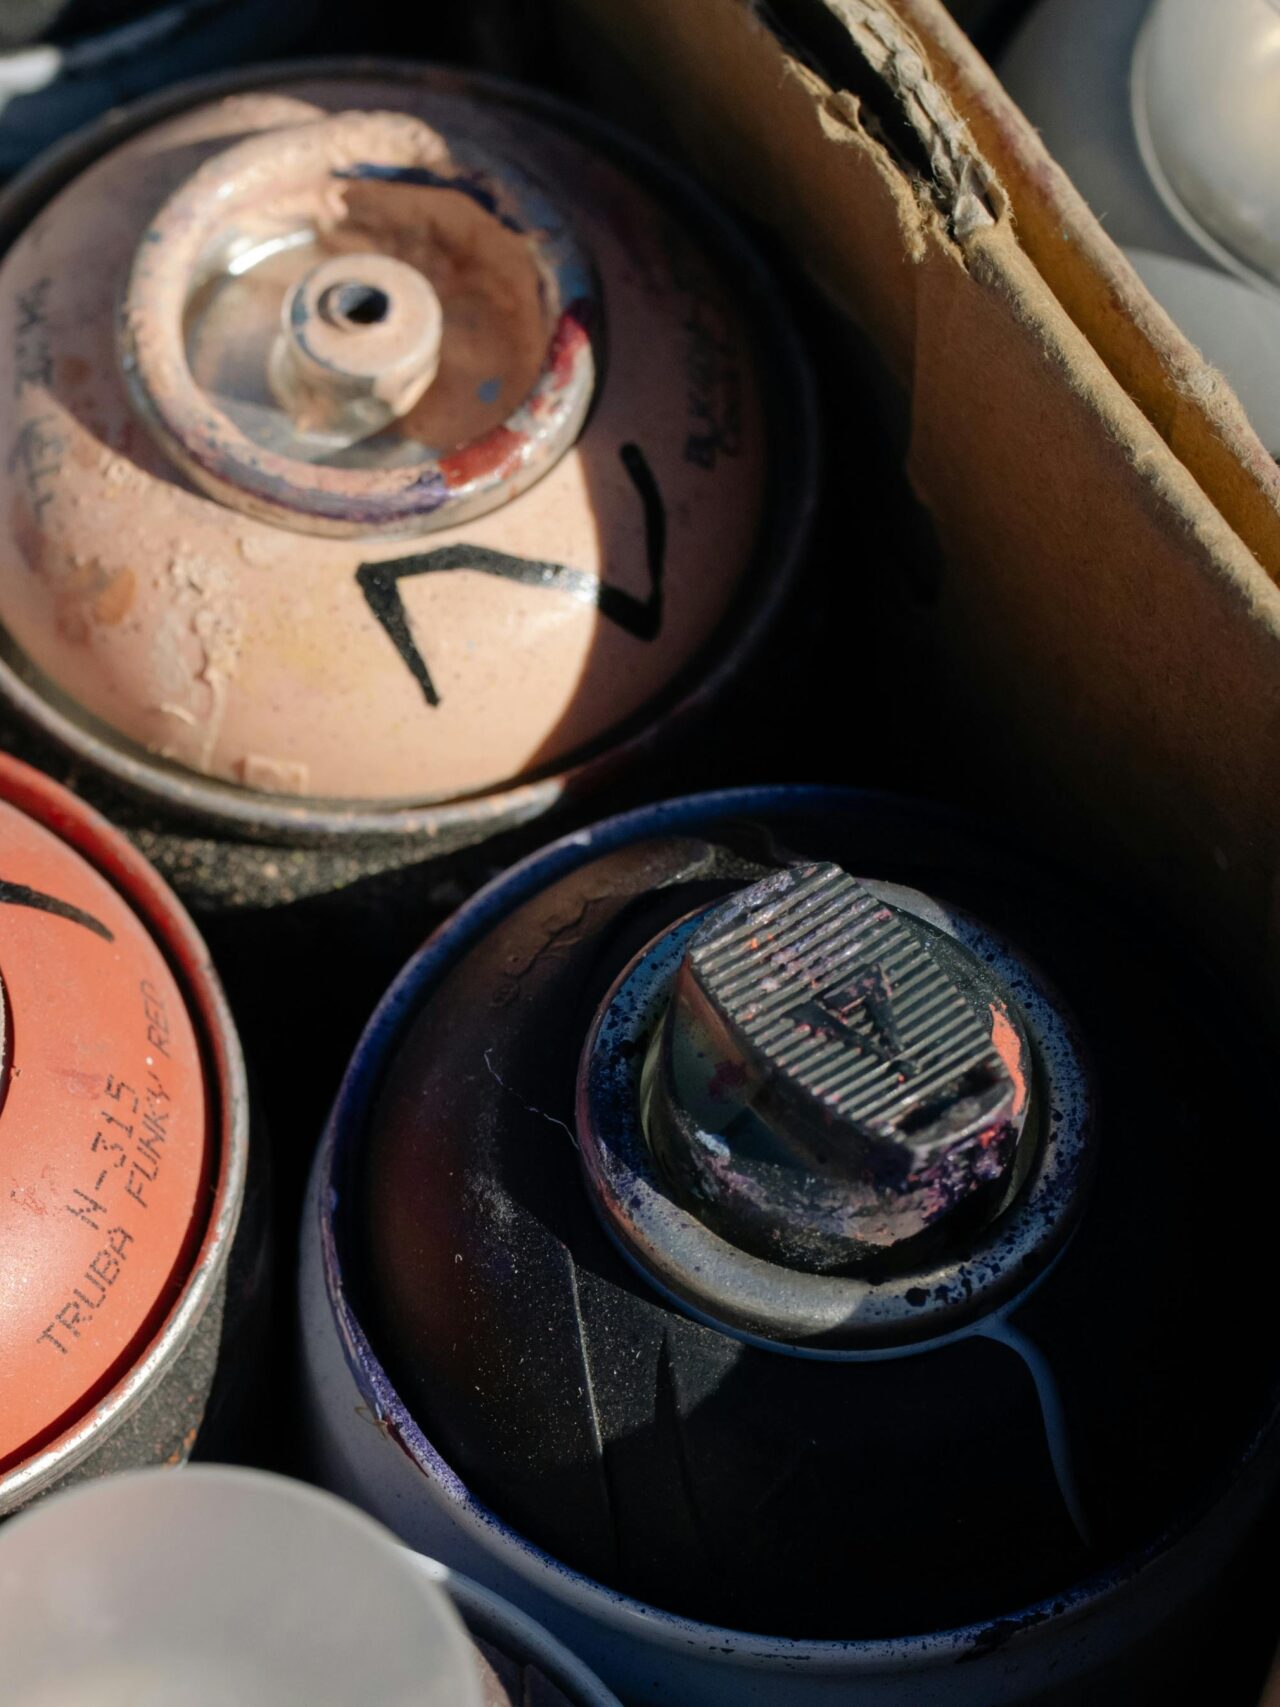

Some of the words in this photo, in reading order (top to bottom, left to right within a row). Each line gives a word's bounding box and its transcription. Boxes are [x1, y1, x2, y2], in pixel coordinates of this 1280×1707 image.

[140, 978, 172, 1059] RED
[66, 1073, 139, 1231] N-315
[124, 1070, 172, 1209] FUNKY
[36, 1226, 135, 1355] TRUBA
